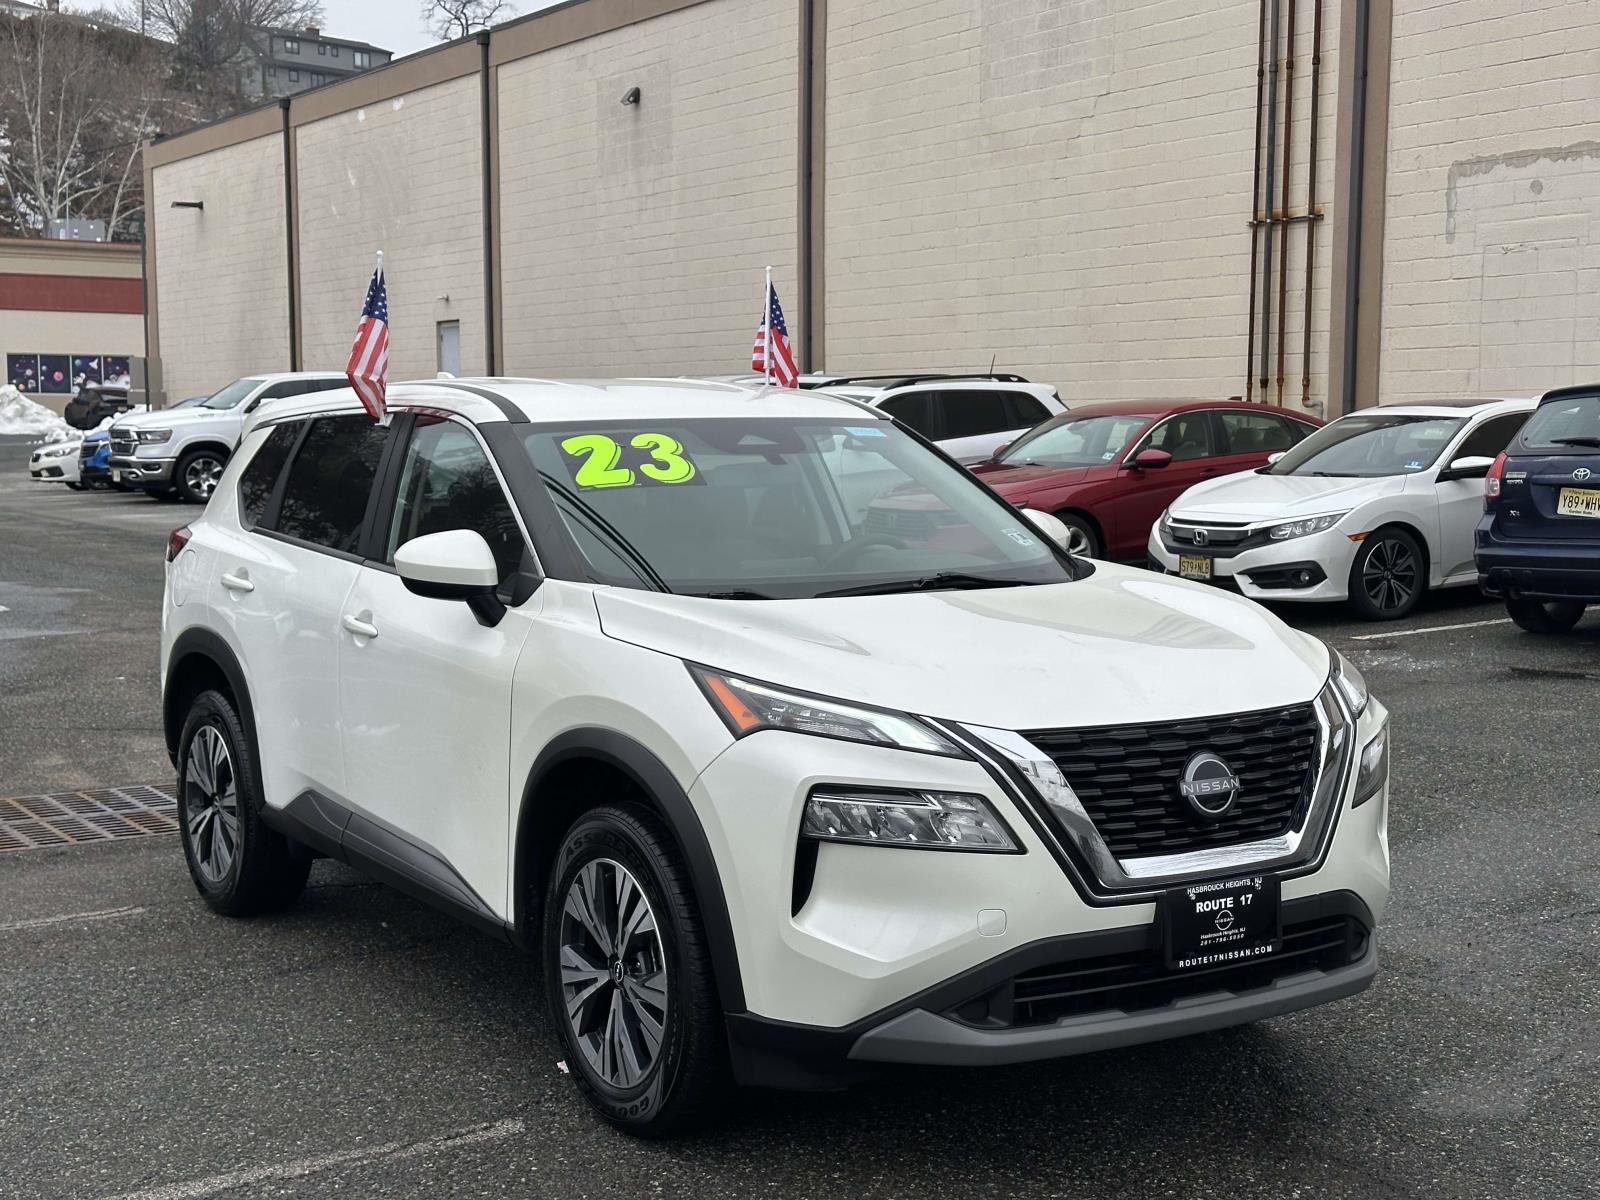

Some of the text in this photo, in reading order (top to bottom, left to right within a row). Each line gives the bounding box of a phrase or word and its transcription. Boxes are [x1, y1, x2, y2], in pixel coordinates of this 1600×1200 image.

[561, 433, 696, 488] 23
[1183, 778, 1239, 793] NISSAN
[1187, 882, 1225, 895] HASBROUCK
[1196, 893, 1253, 913] ROUTE 17
[1214, 915, 1235, 924] NISSAN
[1179, 945, 1273, 968] ROUTE17NISSAN.COM
